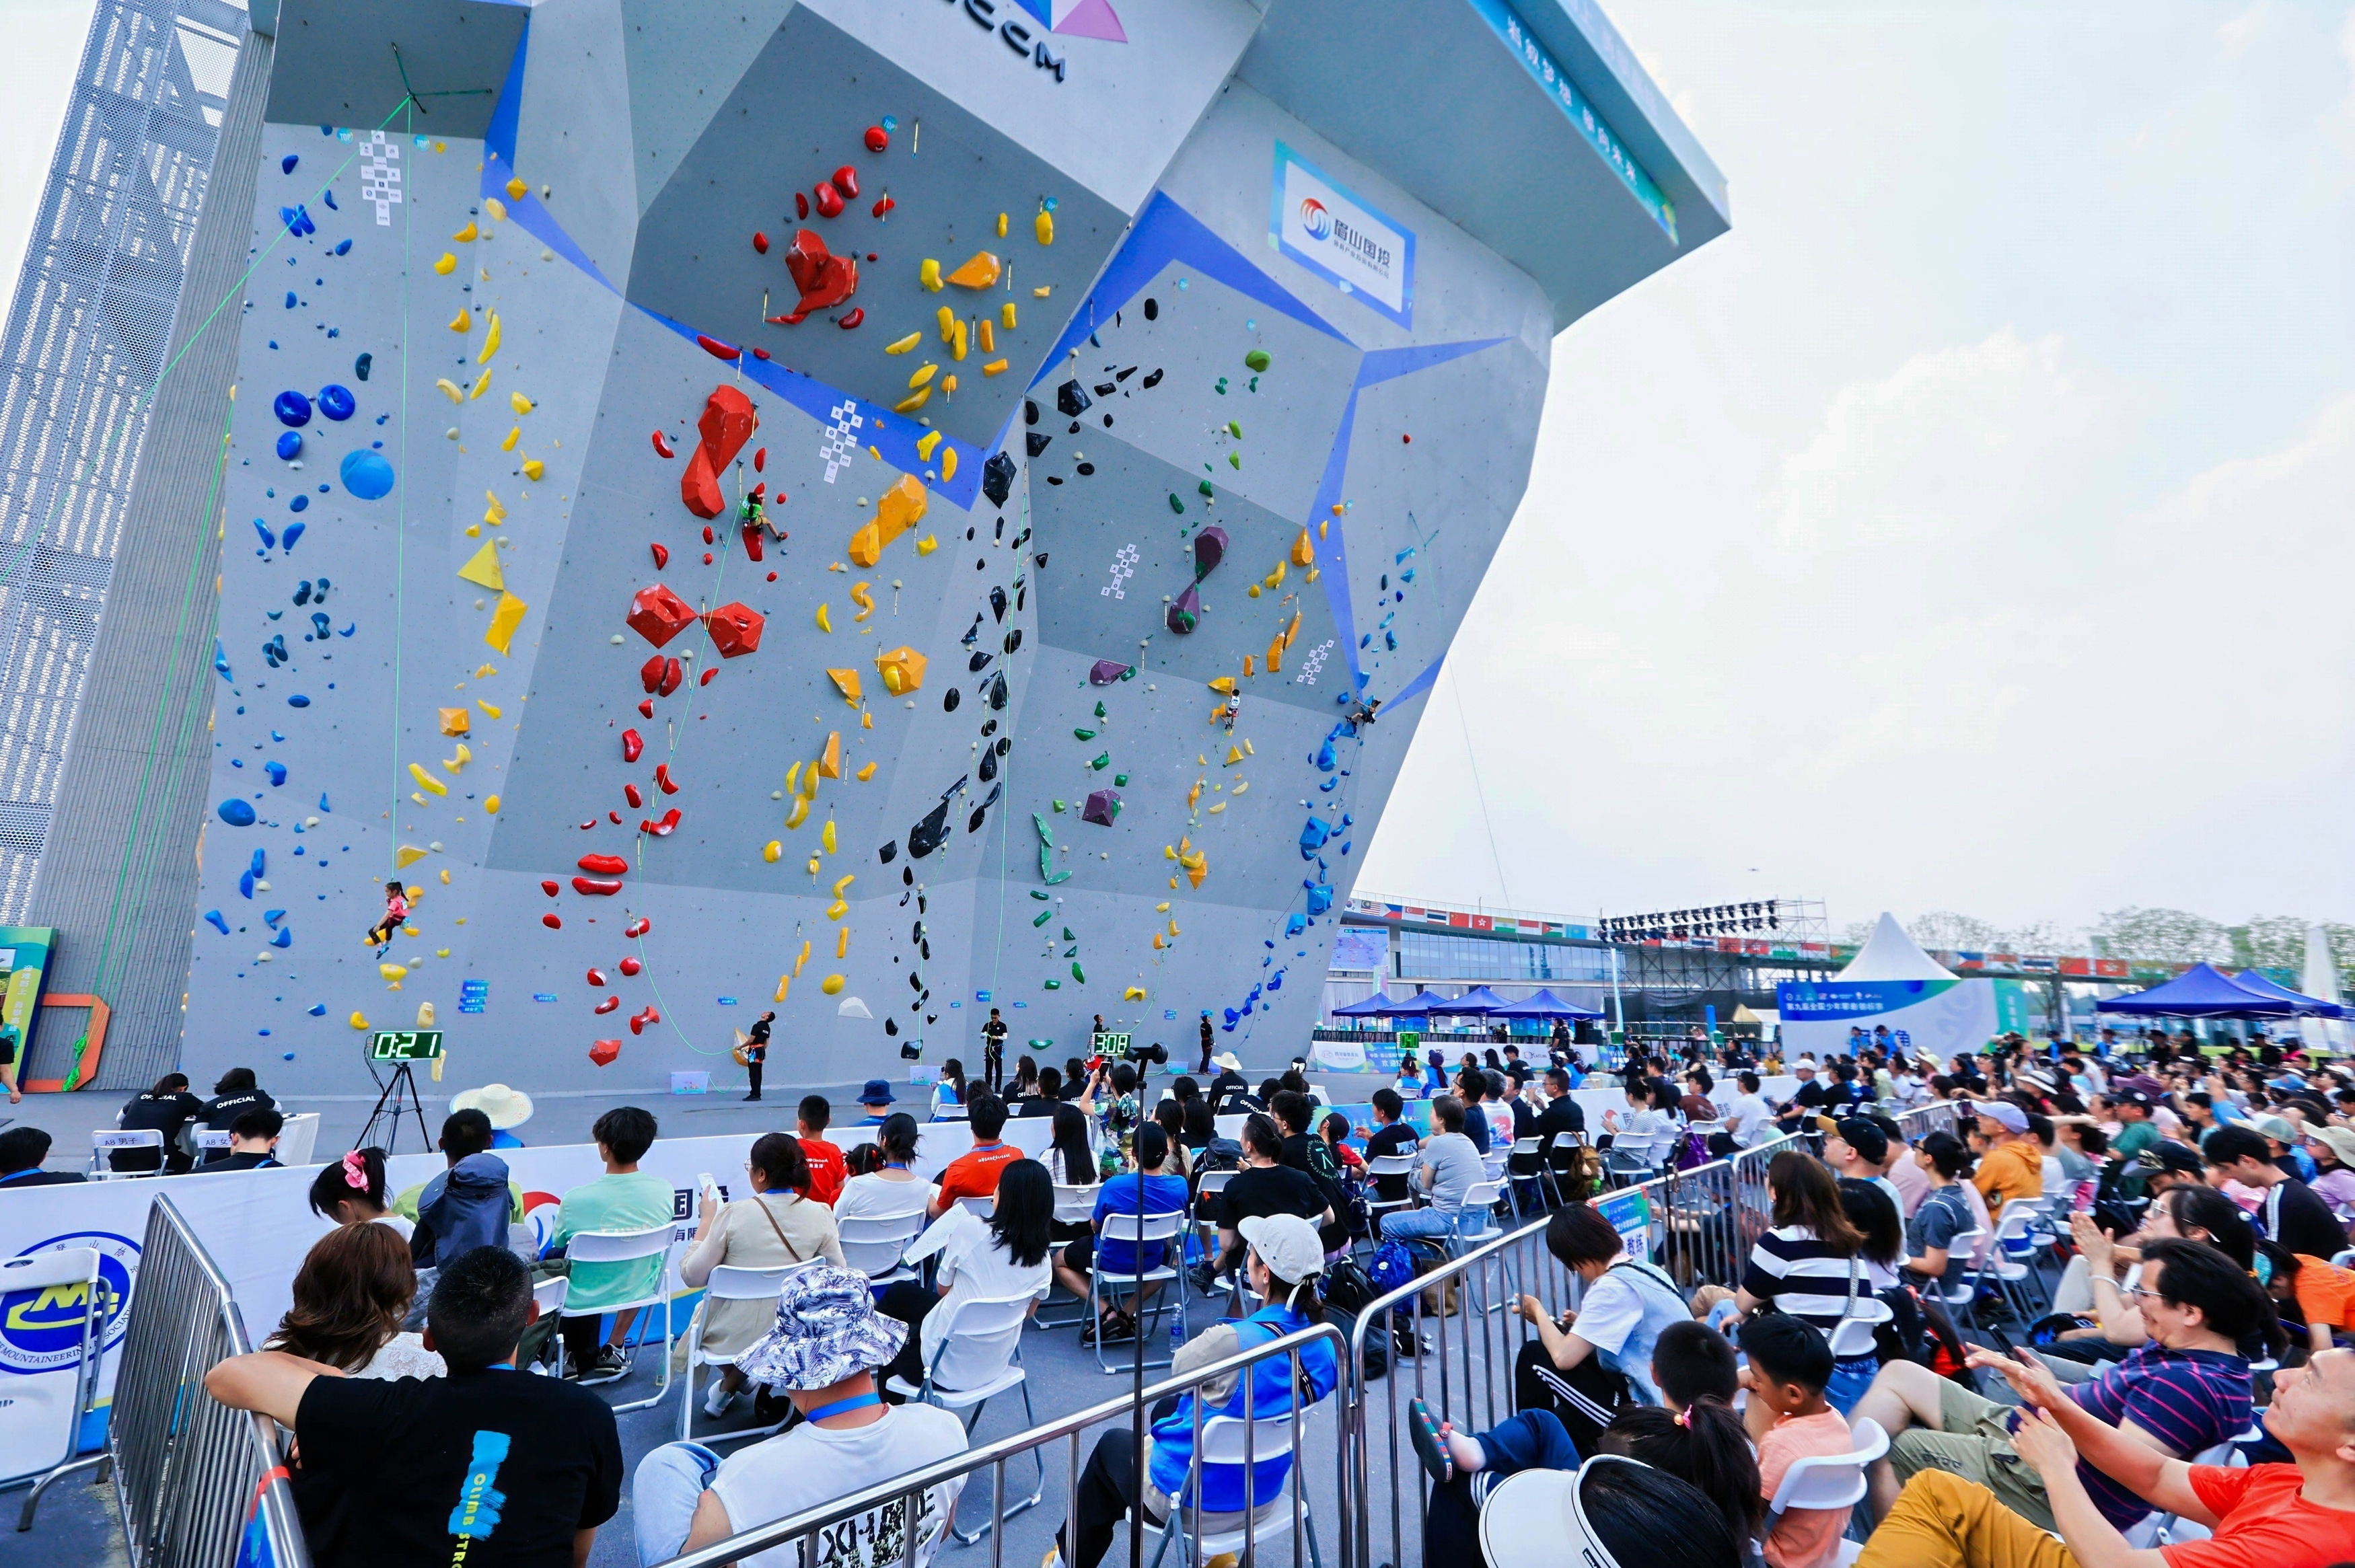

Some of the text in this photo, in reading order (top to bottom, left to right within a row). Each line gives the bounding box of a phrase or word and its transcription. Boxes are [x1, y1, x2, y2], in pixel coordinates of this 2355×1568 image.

[943, 0, 1065, 83] CCM
[884, 120, 895, 129] TOP
[340, 133, 351, 141] TOP
[1047, 201, 1055, 210] TOP
[1334, 219, 1390, 268] 眉山国投
[375, 1033, 437, 1059] 0:21
[1095, 1035, 1127, 1053] 3:08
[217, 1096, 256, 1109] OFFICIAL
[1240, 1100, 1263, 1113] OFFICIA
[1627, 1233, 1644, 1256] 教练
[1, 1342, 92, 1364] MOUNTAINEERIN
